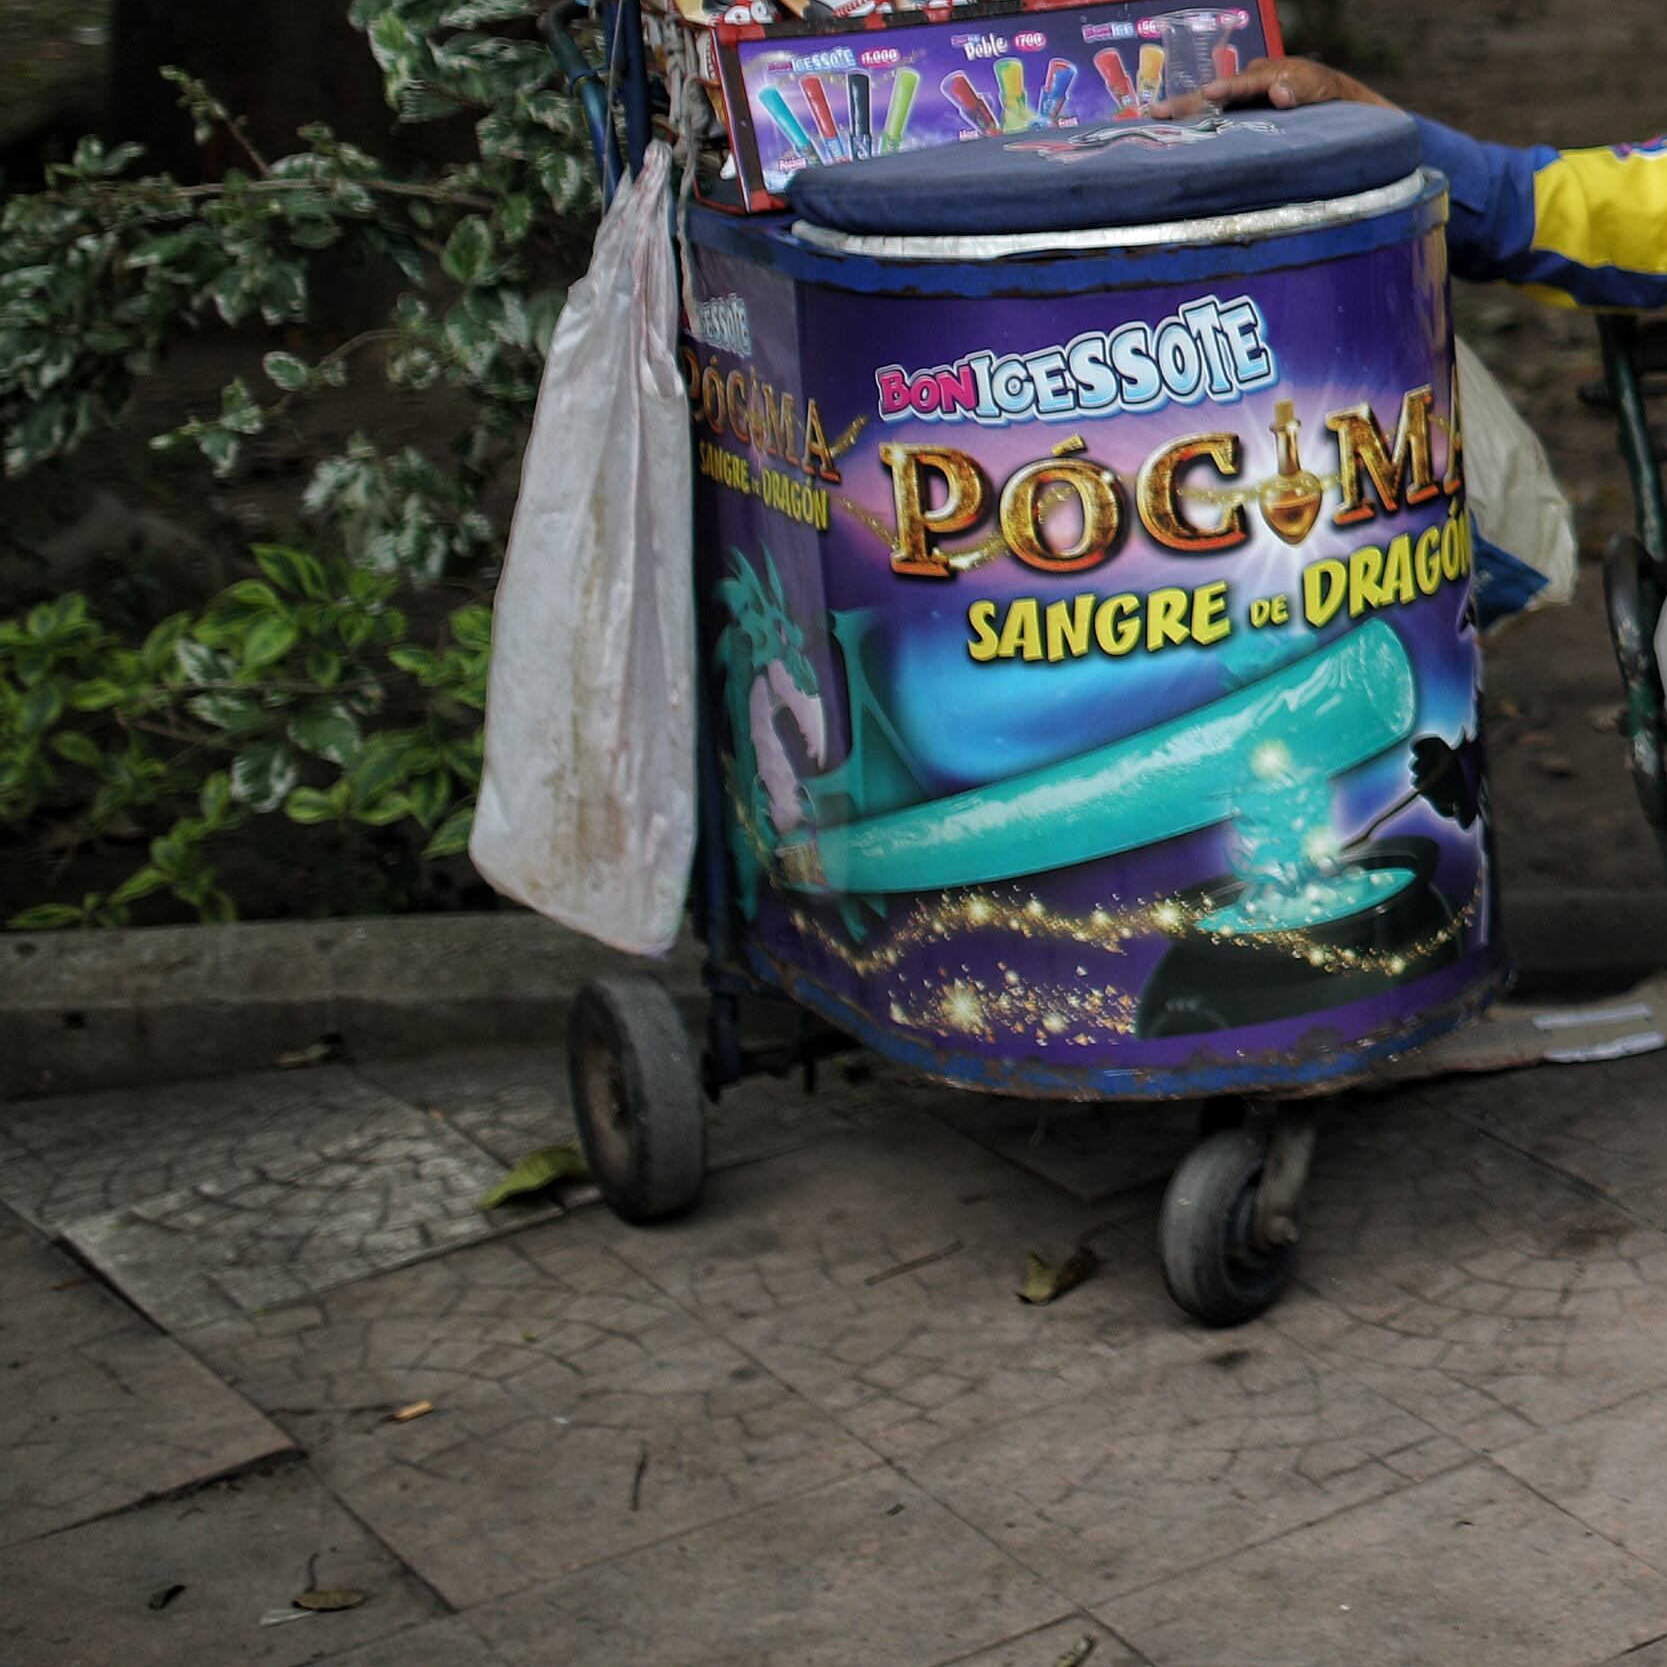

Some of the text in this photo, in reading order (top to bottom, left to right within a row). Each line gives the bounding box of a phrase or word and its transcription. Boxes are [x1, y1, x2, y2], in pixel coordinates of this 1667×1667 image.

[963, 33, 1008, 61] Doble
[876, 296, 1277, 427] BONICESSOTE
[700, 439, 750, 495] SANGRE
[761, 468, 830, 531] DRAGÓN
[967, 498, 1470, 664] SANGRE DE DRAGÓN
